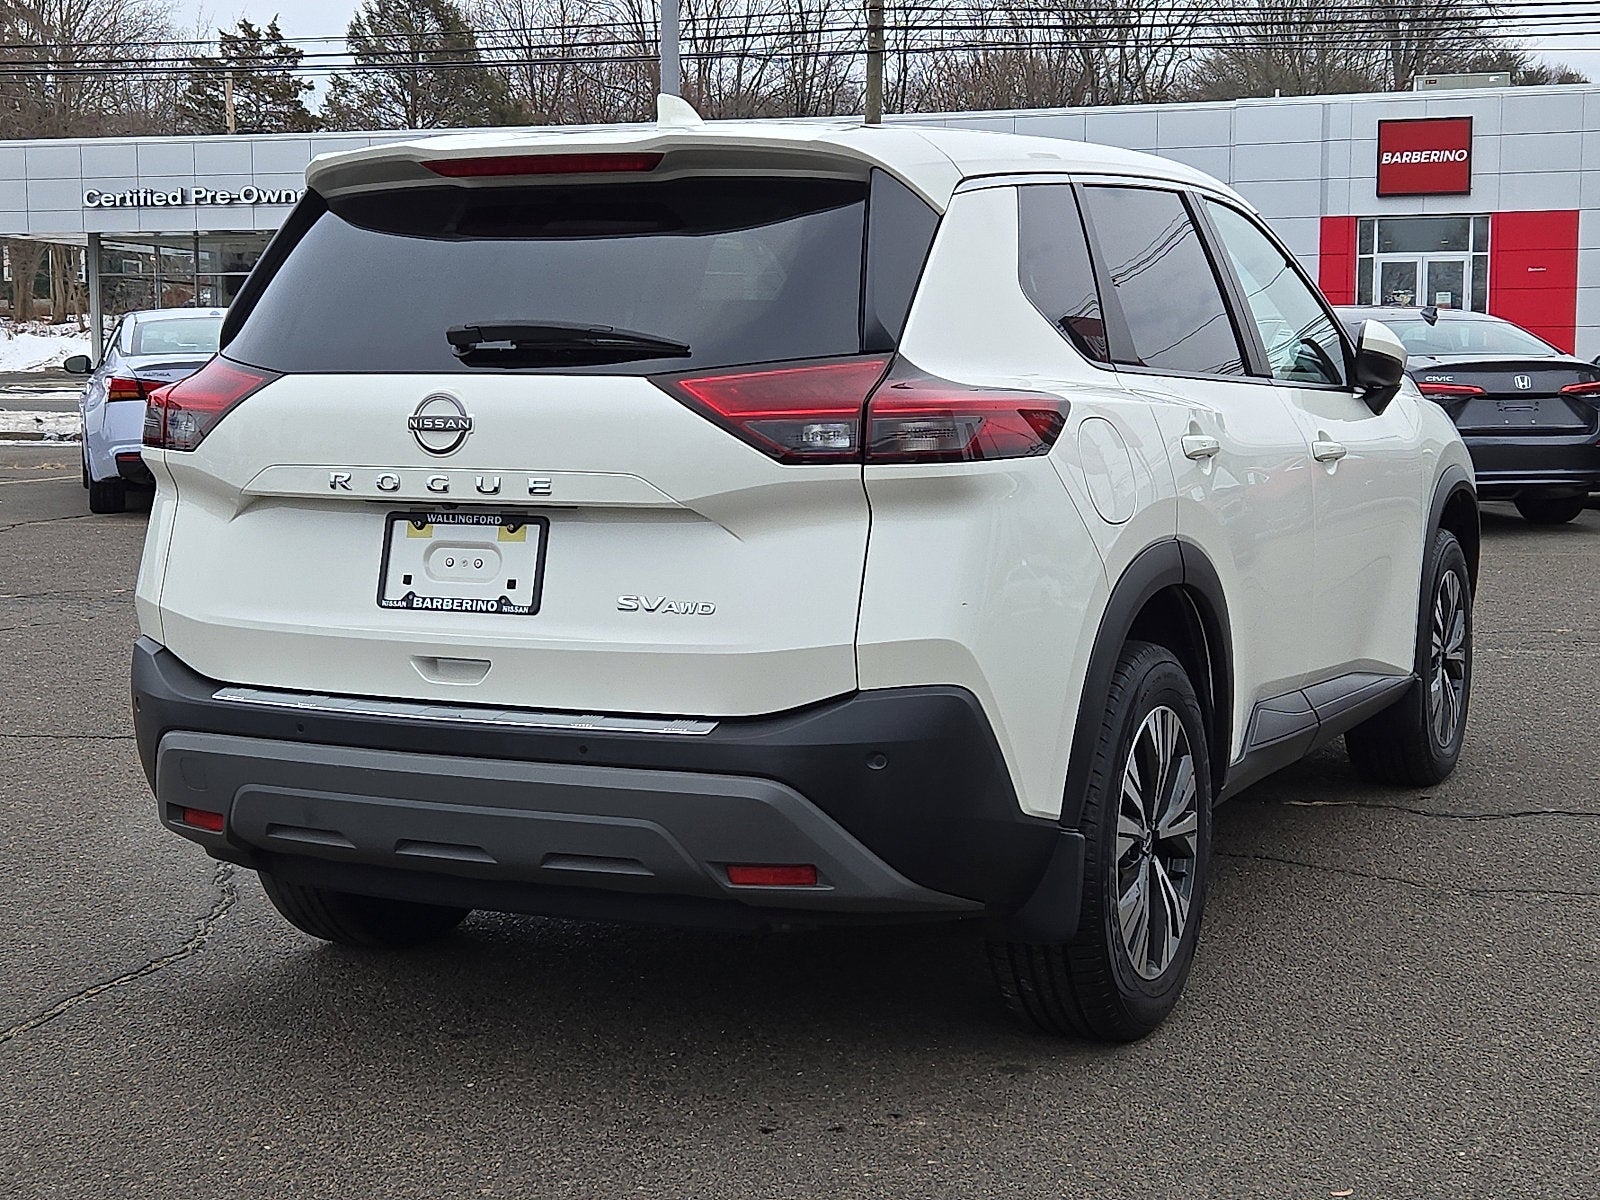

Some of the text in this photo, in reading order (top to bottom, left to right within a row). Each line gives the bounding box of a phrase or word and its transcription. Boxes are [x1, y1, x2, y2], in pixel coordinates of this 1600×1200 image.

[1381, 149, 1468, 165] BARBERINO
[82, 187, 182, 208] Certified
[409, 418, 470, 429] NISSAN
[329, 471, 552, 496] ROGUE
[427, 513, 502, 525] WALLINGFORD
[381, 597, 529, 614] NISSAN BARBERINO NISSAN
